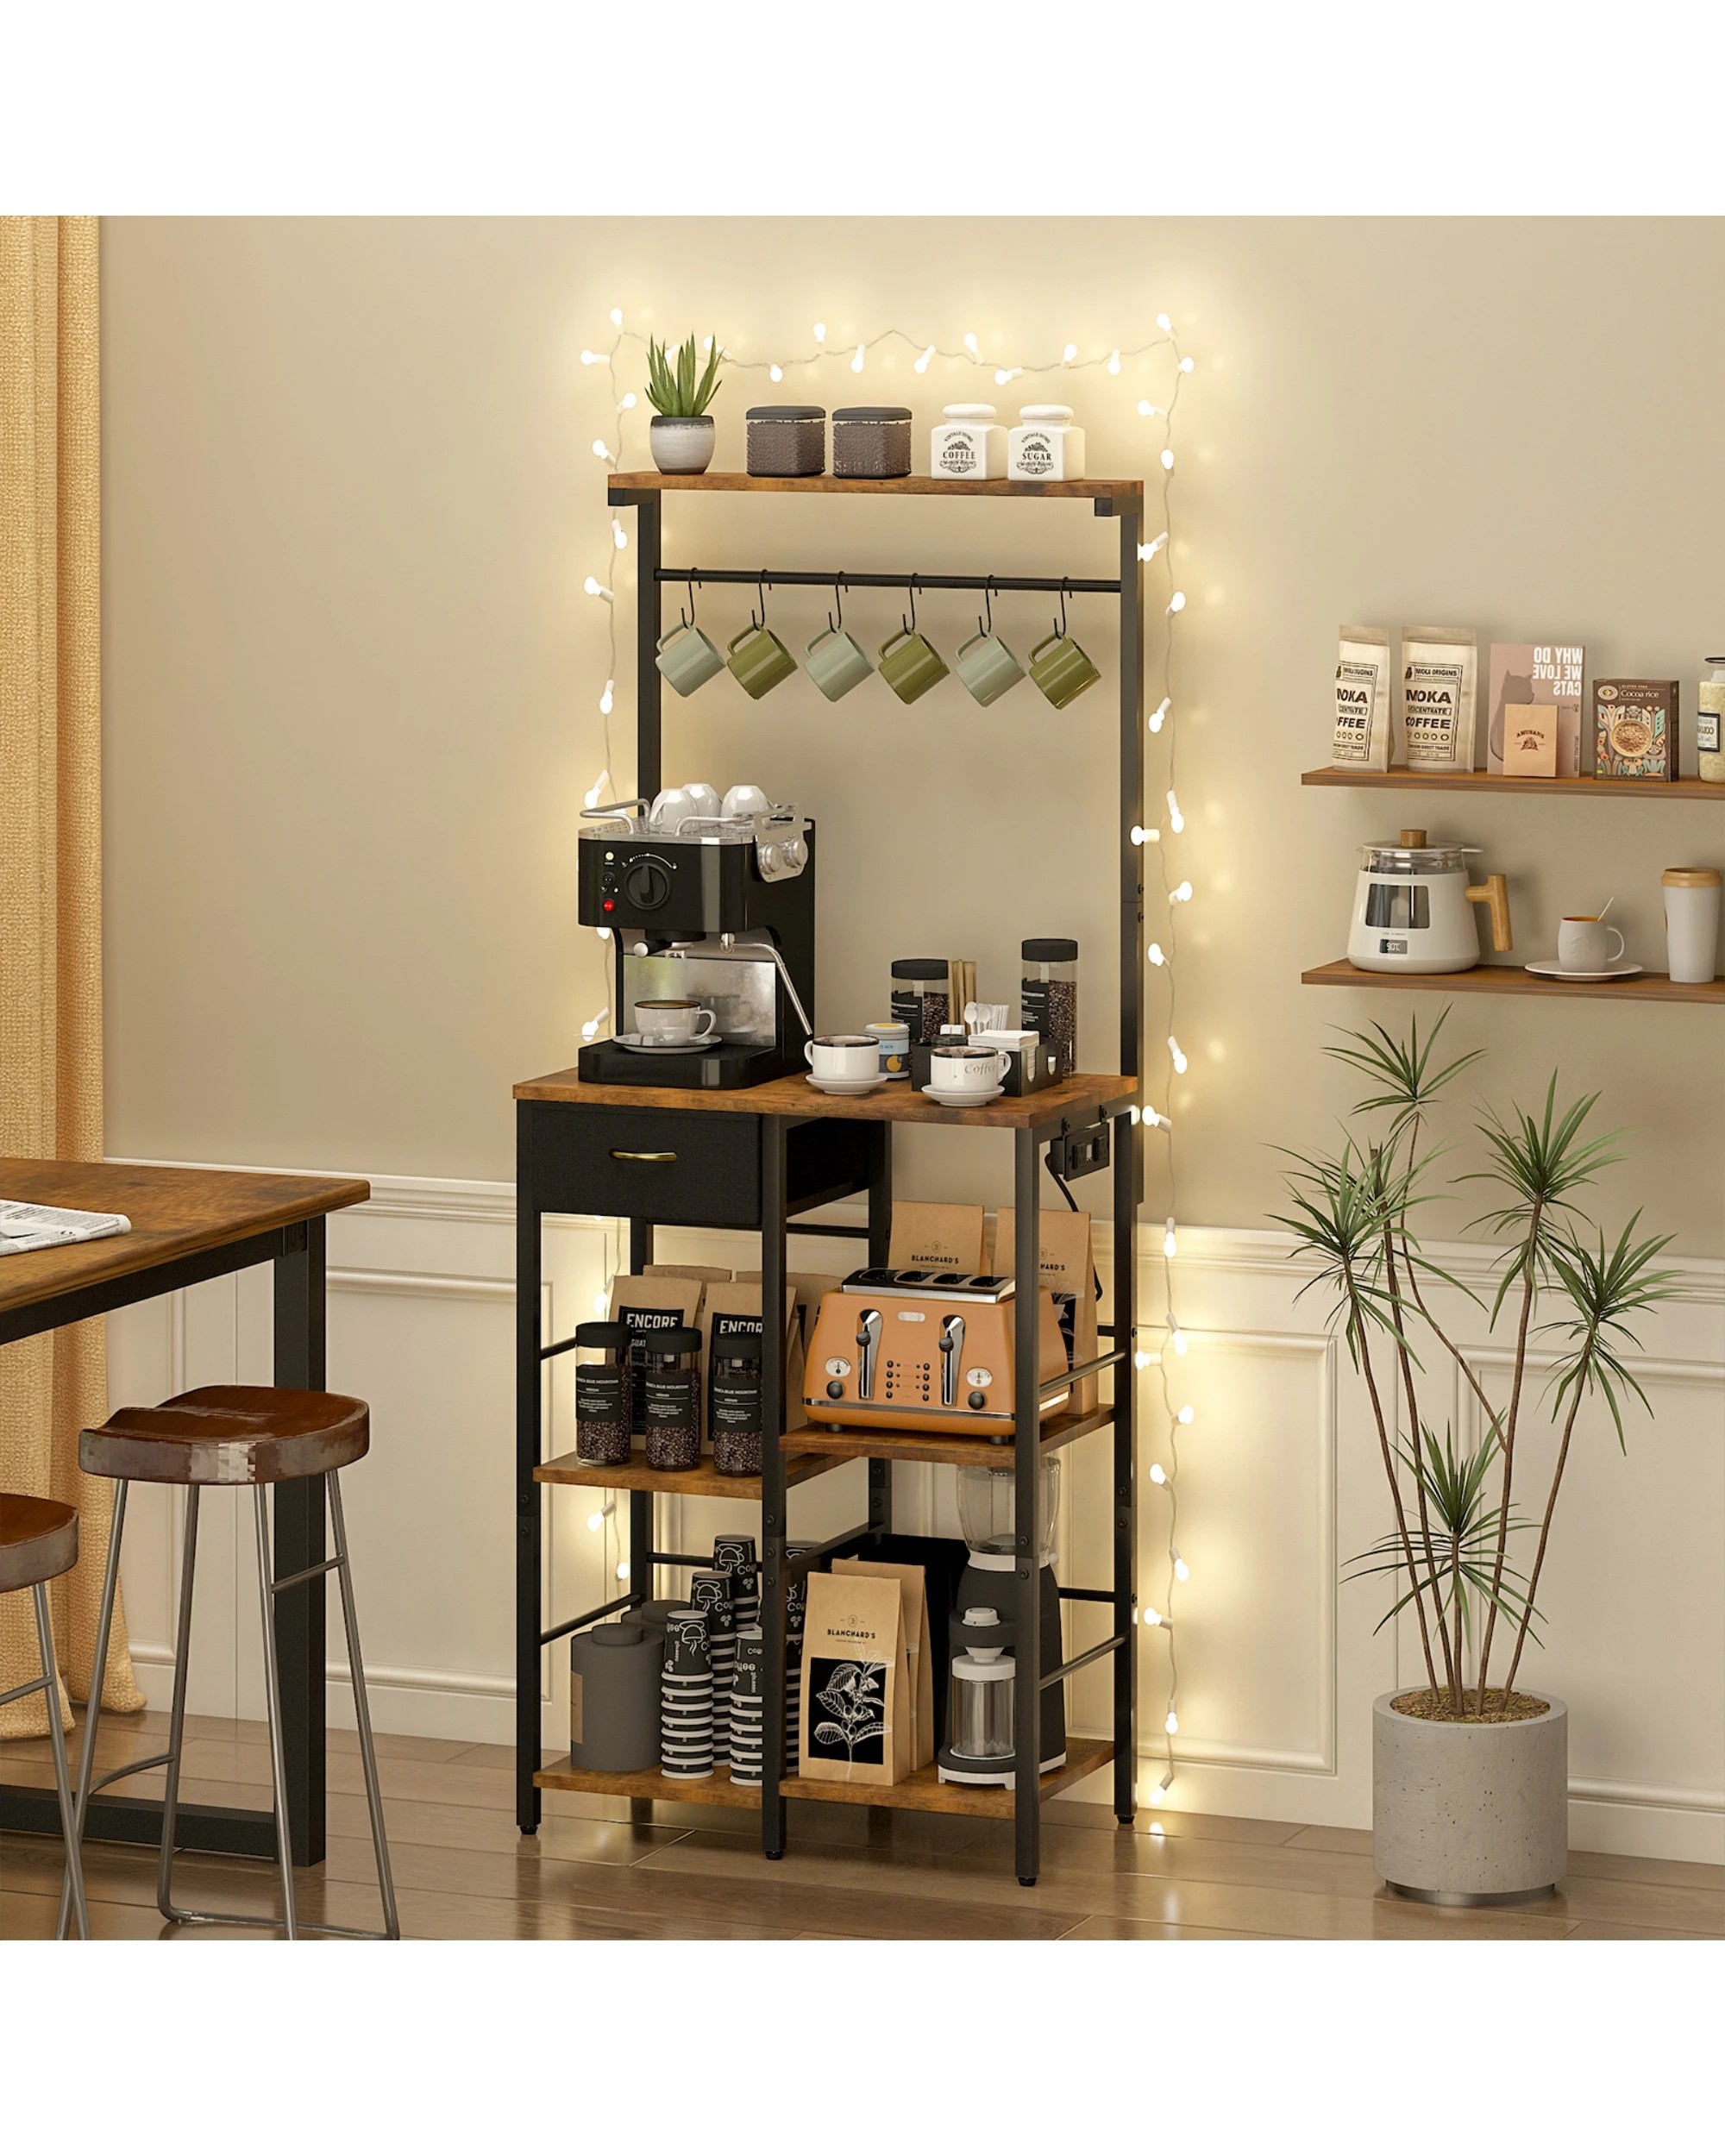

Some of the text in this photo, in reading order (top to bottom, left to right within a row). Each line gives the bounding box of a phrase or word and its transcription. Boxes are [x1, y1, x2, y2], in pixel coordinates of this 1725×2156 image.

[943, 451, 975, 460] COFFEE
[1621, 689, 1659, 699] Cocoa rice
[1337, 717, 1366, 729] FFEE
[1405, 717, 1451, 730] COFFEE
[911, 1254, 959, 1264] BLANCHARD'S
[1040, 1263, 1066, 1271] HARD'S
[626, 1313, 678, 1329] ENCORE
[719, 1319, 762, 1333] ENCOR
[827, 1628, 876, 1639] BLANCHARD'S
